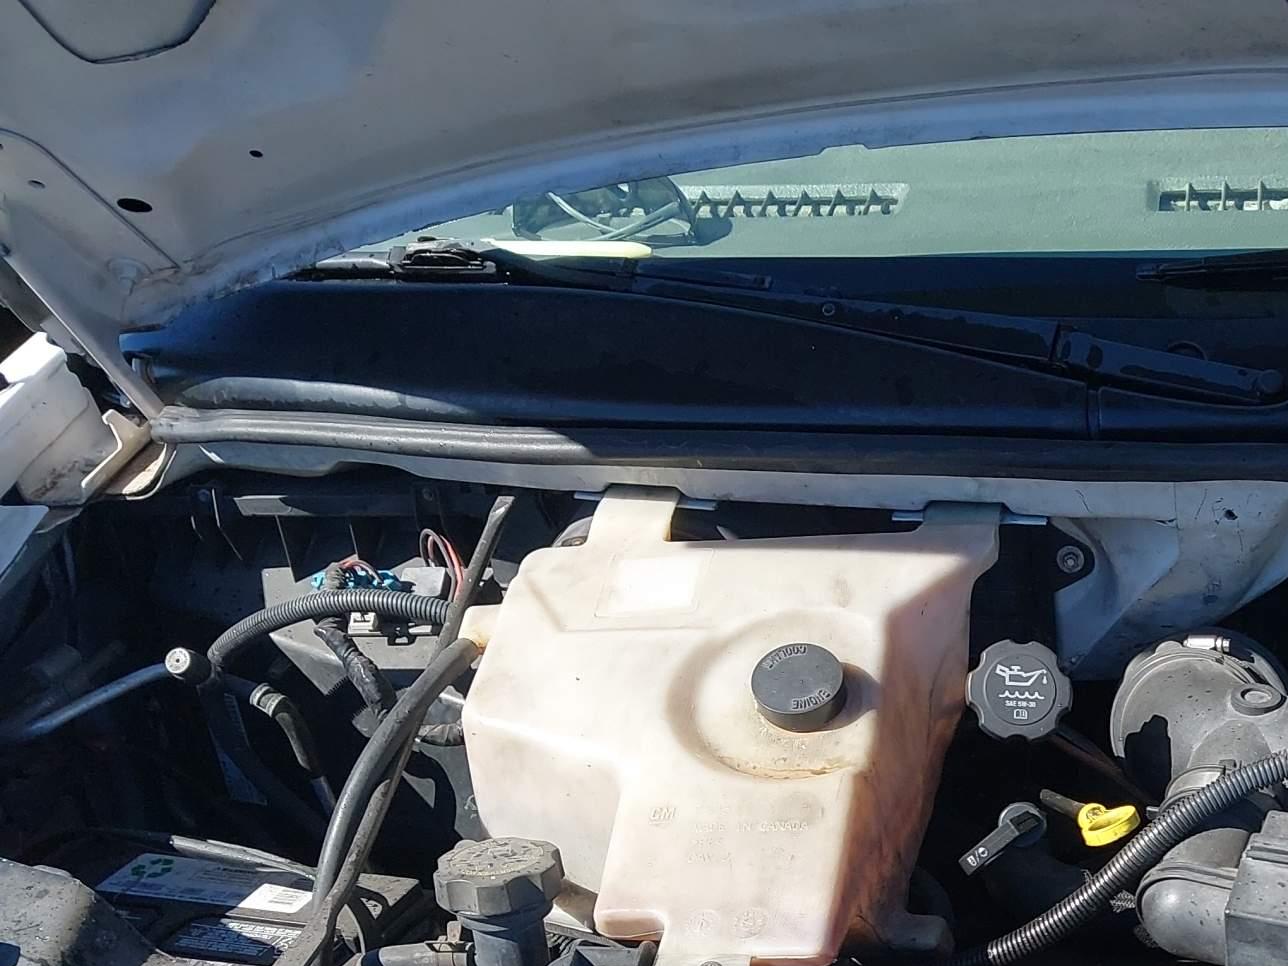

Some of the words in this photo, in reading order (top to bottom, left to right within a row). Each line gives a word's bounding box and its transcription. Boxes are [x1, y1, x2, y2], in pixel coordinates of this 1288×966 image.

[763, 645, 808, 669] COOLANT
[792, 689, 832, 711] ENGINE
[760, 821, 809, 833] CANADA
